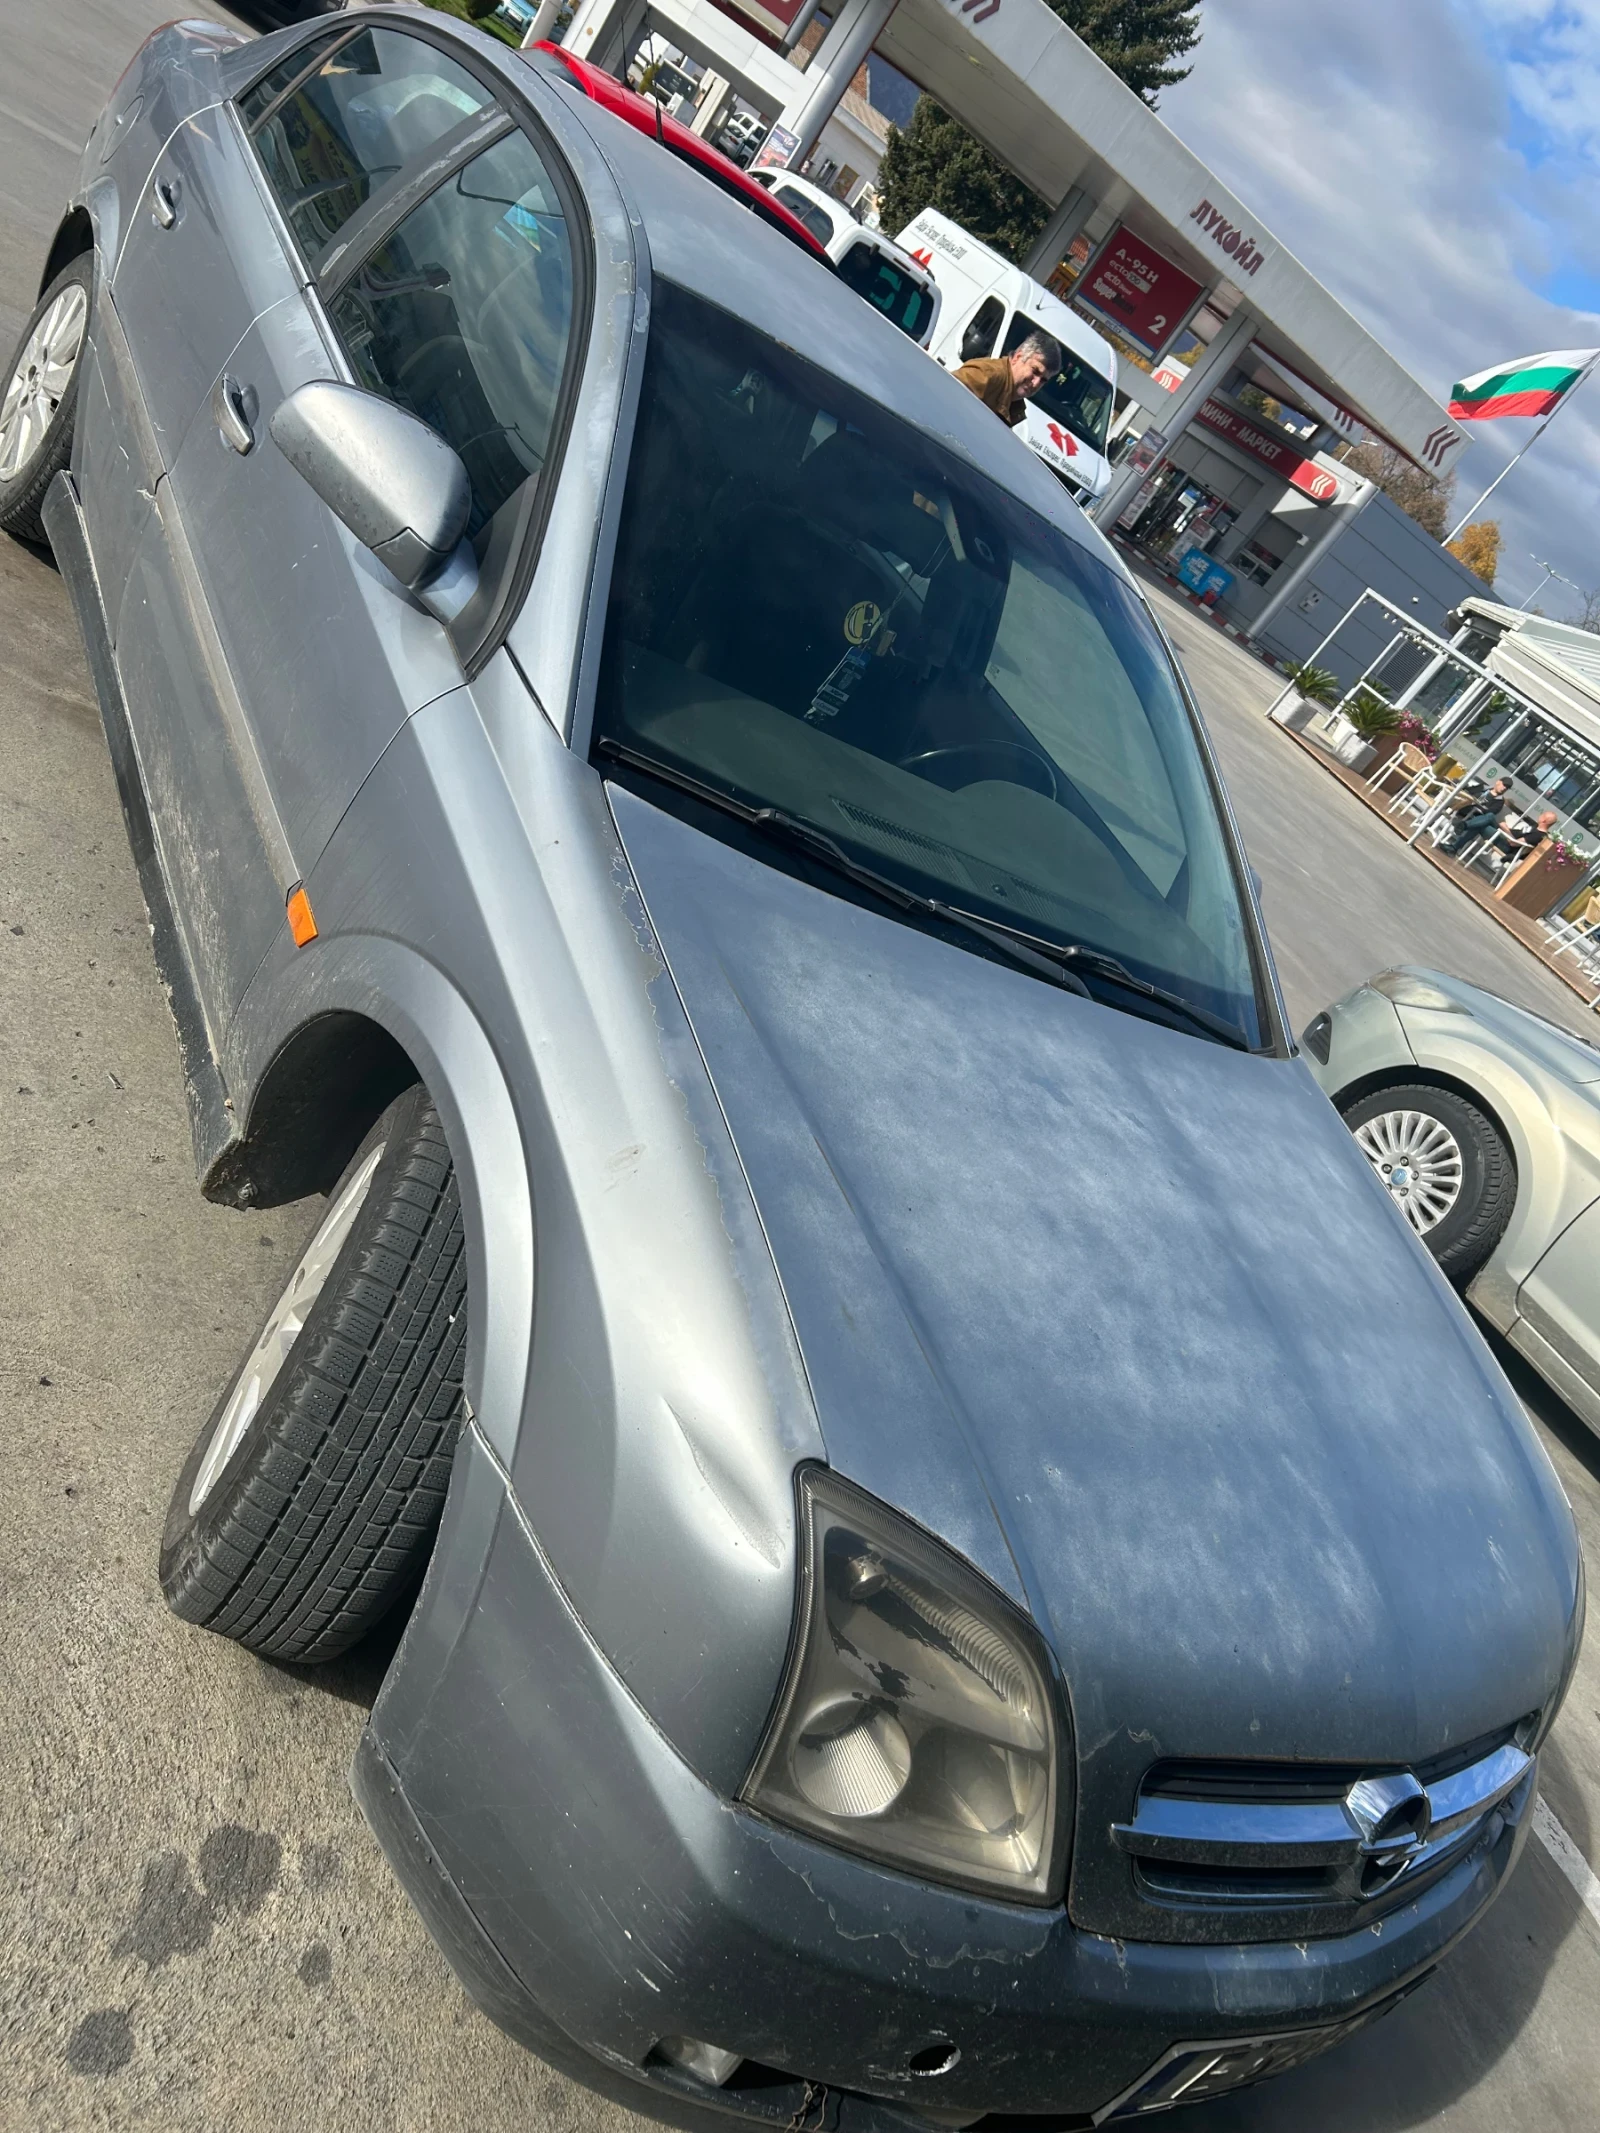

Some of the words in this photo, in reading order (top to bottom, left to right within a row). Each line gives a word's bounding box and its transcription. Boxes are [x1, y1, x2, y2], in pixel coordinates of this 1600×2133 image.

[1190, 199, 1265, 276] ЛУКОЙЛ
[1148, 315, 1167, 335] 2
[1236, 426, 1282, 461] МАРКЕТ
